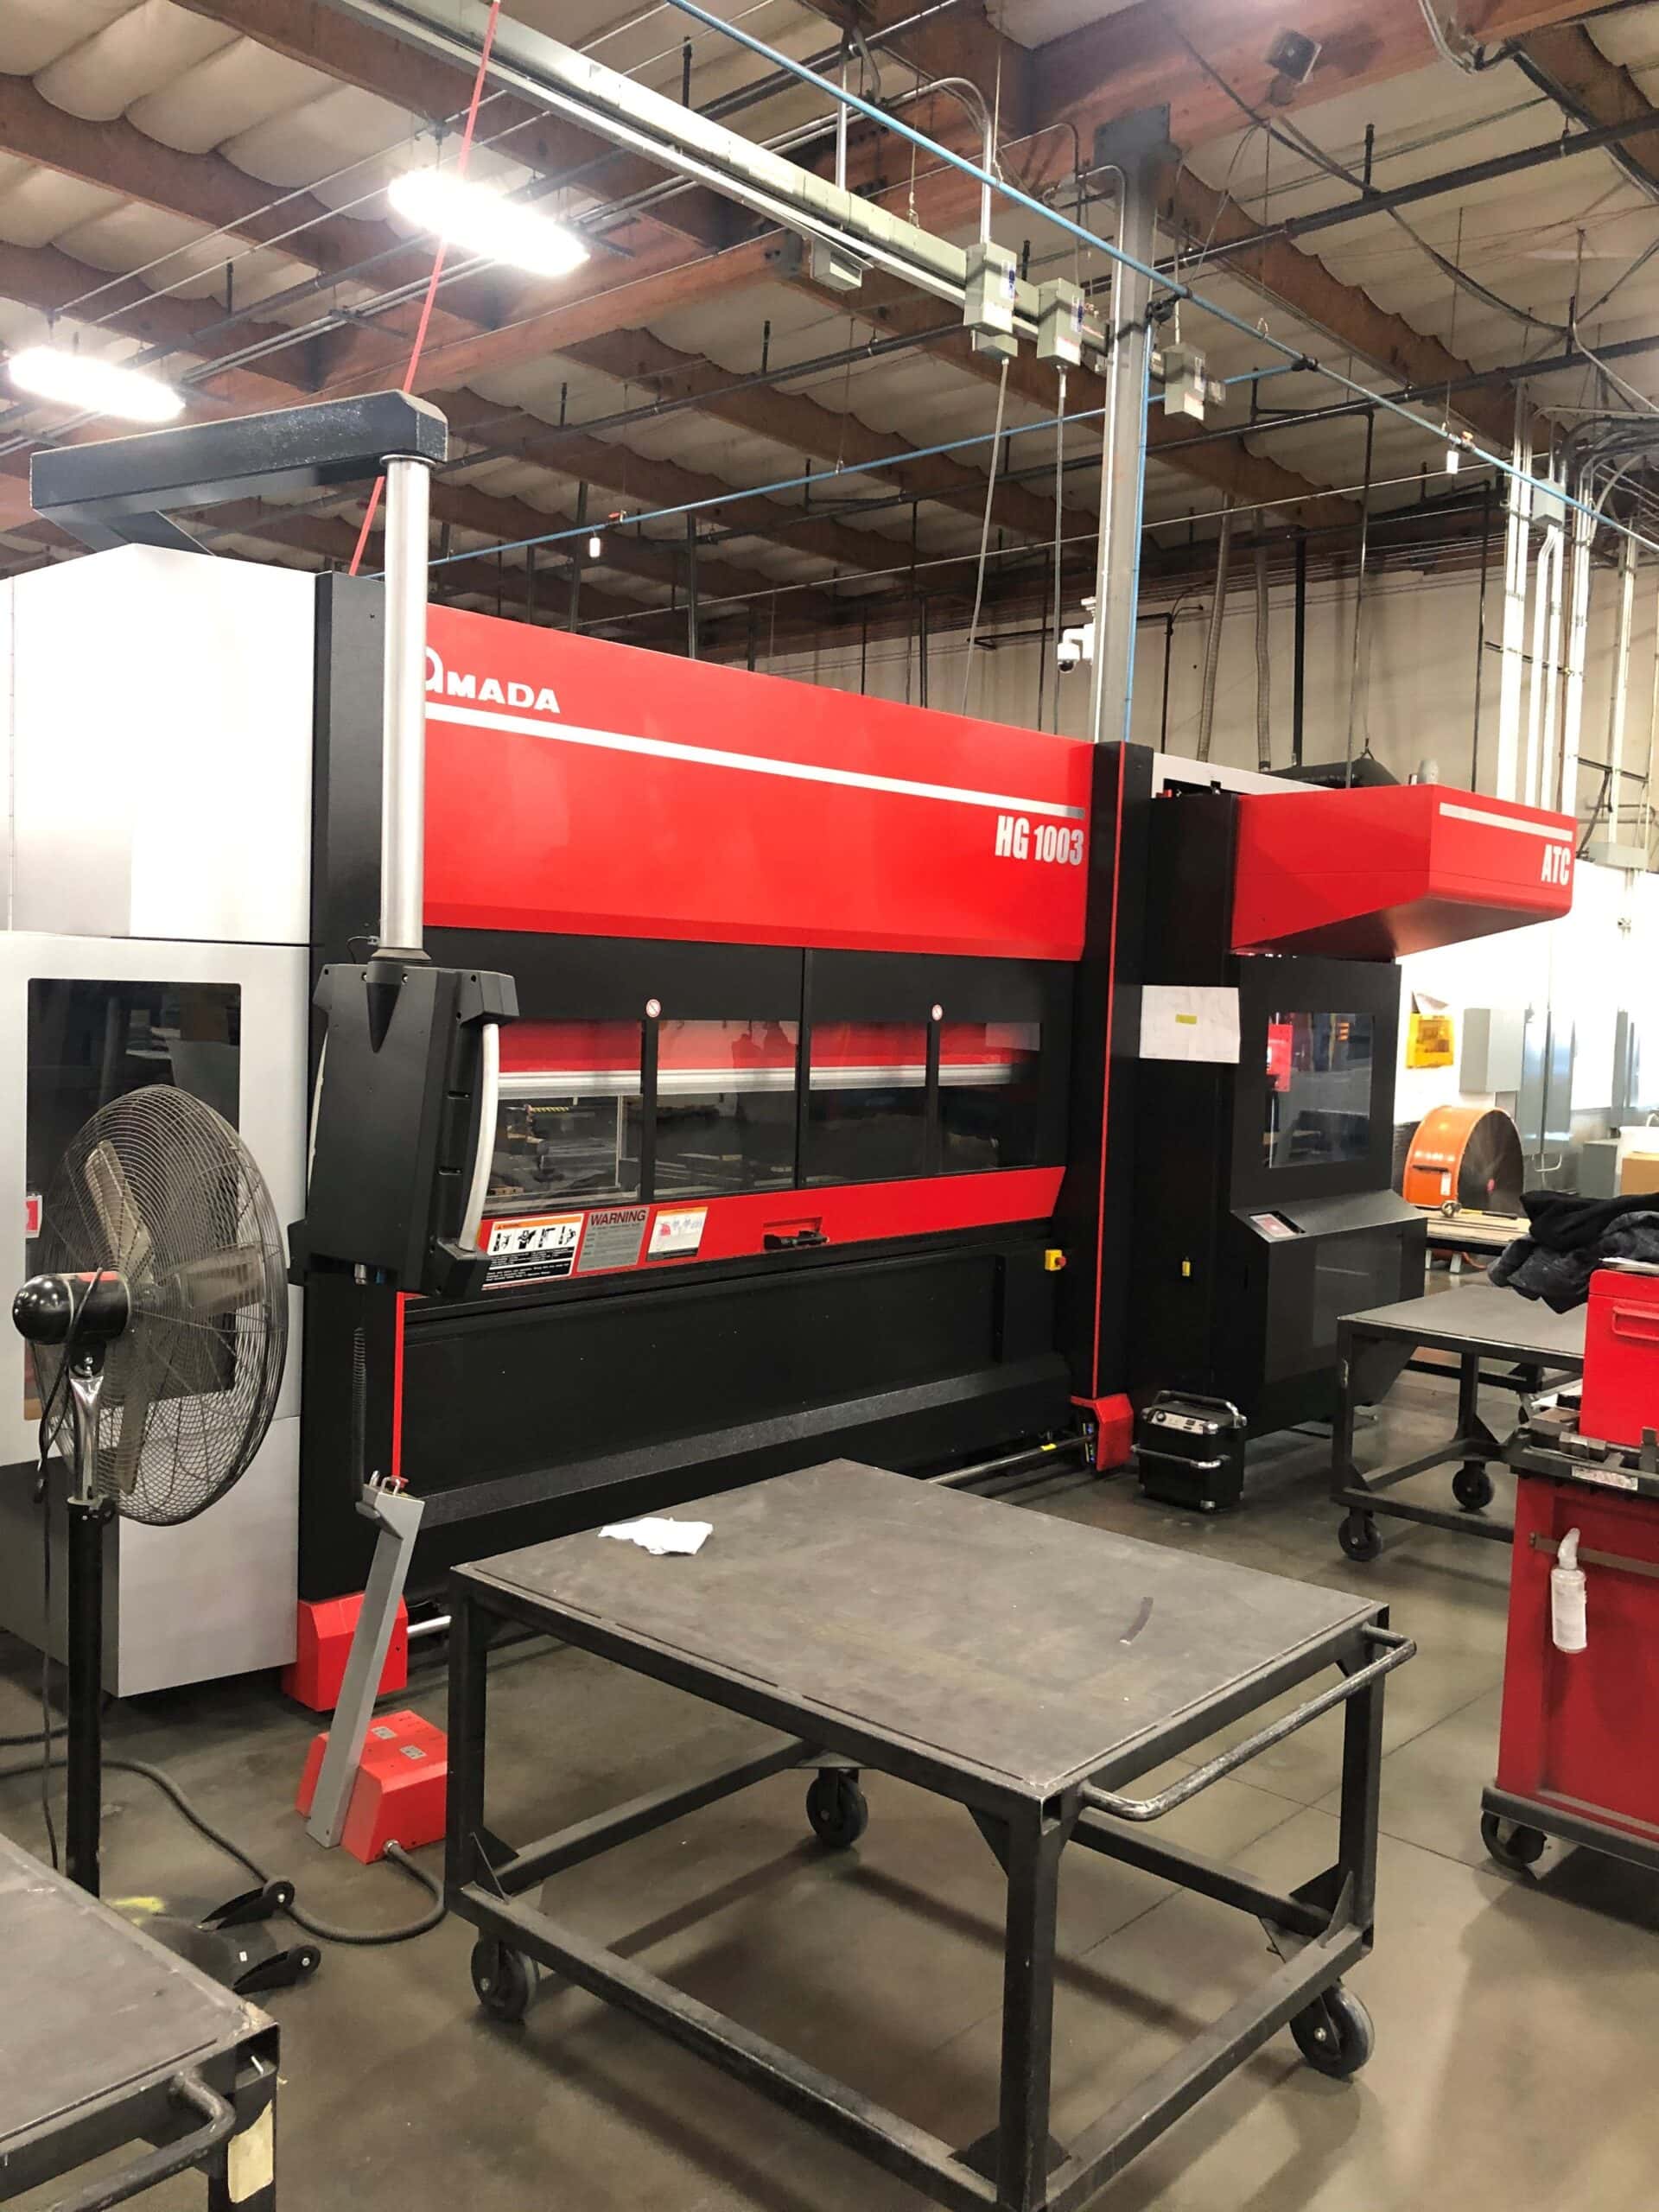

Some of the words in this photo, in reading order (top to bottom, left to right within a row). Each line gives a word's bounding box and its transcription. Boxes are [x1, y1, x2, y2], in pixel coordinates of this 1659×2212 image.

[995, 815, 1030, 860] HG
[1033, 824, 1084, 866] 1003
[1541, 843, 1571, 886] ATC
[591, 1210, 646, 1226] WARNING
